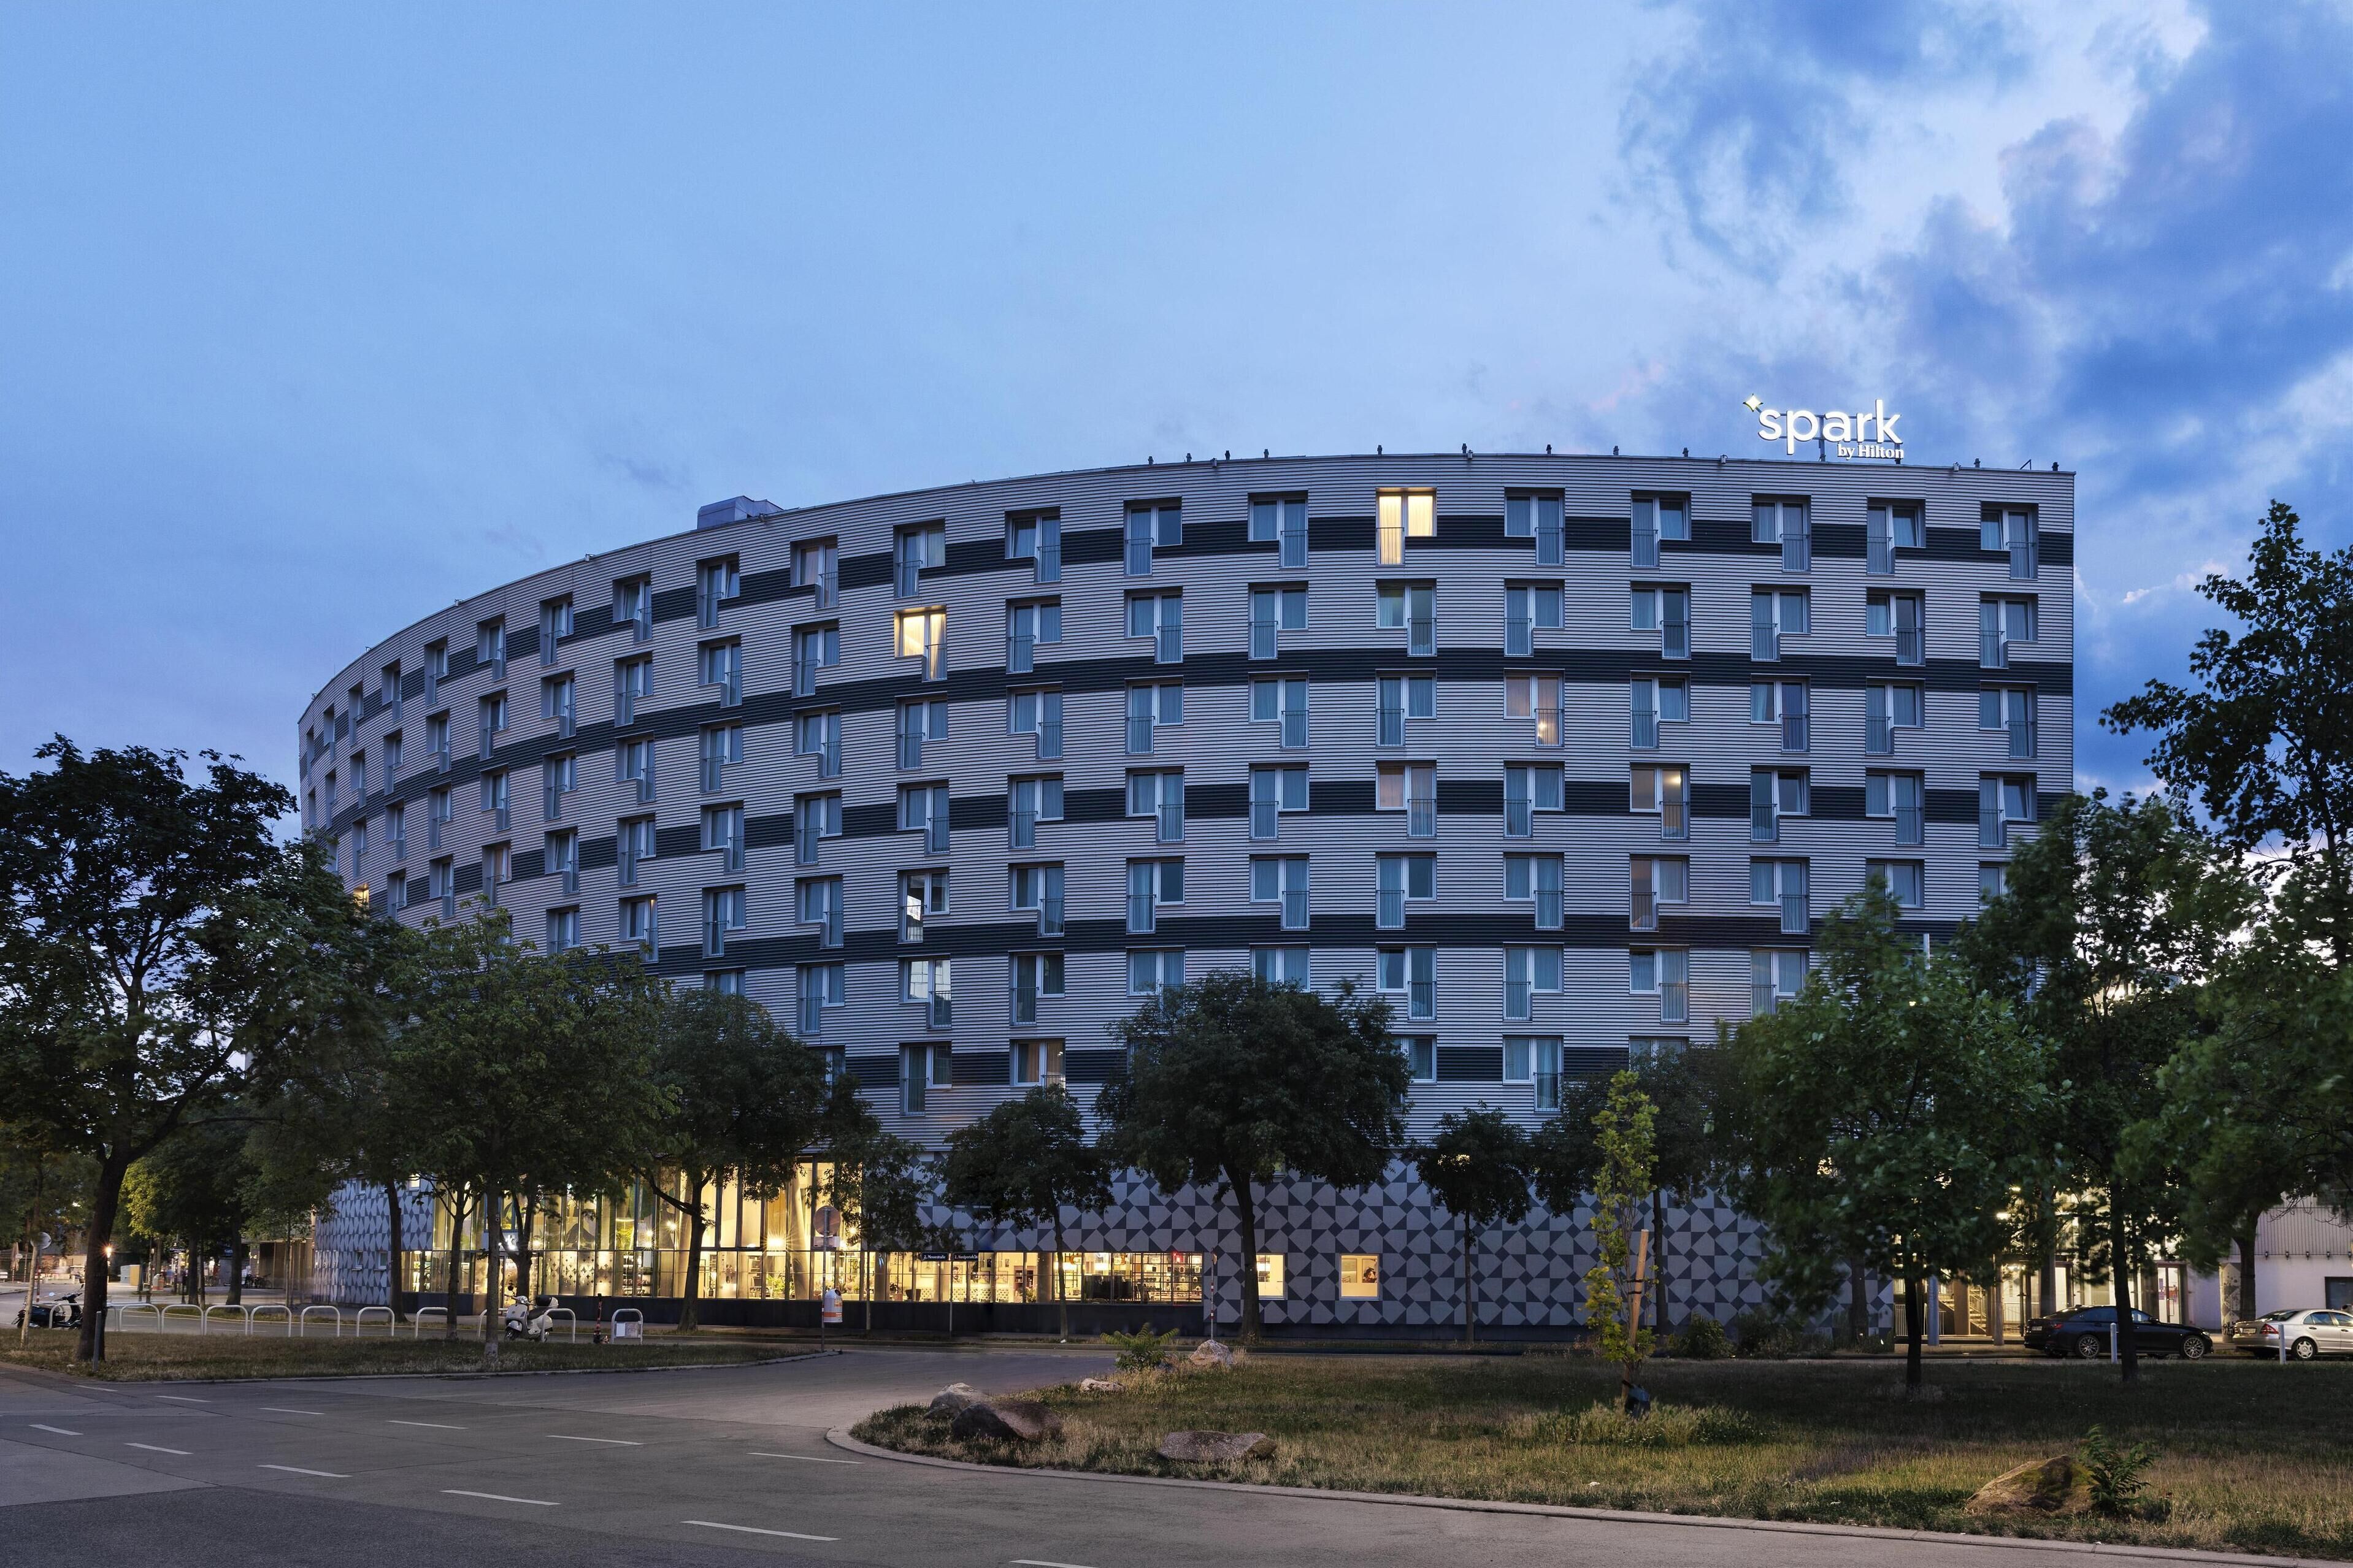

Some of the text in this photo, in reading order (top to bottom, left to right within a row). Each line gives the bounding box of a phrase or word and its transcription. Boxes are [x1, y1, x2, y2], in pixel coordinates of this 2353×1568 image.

[1758, 399, 1903, 455] spark
[1838, 443, 1904, 460] by Hilton
